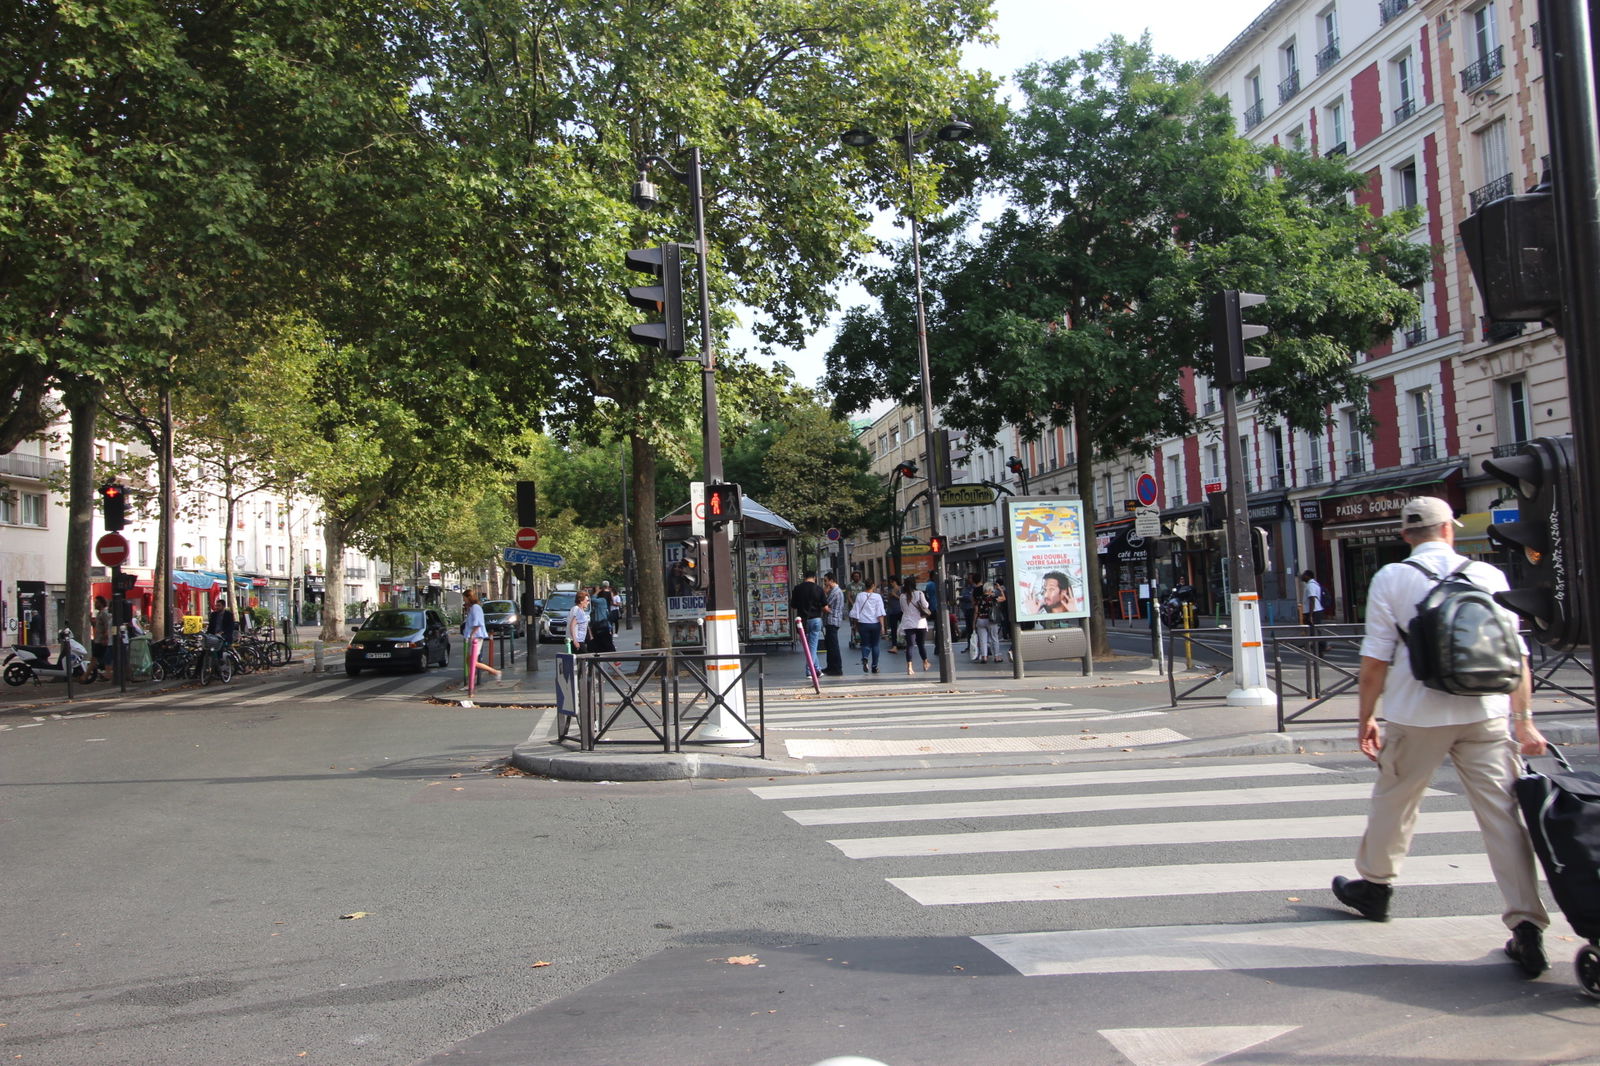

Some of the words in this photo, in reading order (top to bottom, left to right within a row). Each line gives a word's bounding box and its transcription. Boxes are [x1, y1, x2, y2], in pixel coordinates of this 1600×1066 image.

[1336, 505, 1363, 516] PAINS
[1369, 496, 1416, 512] GOURMAN
[1117, 550, 1131, 558] café
[669, 597, 681, 610] DU
